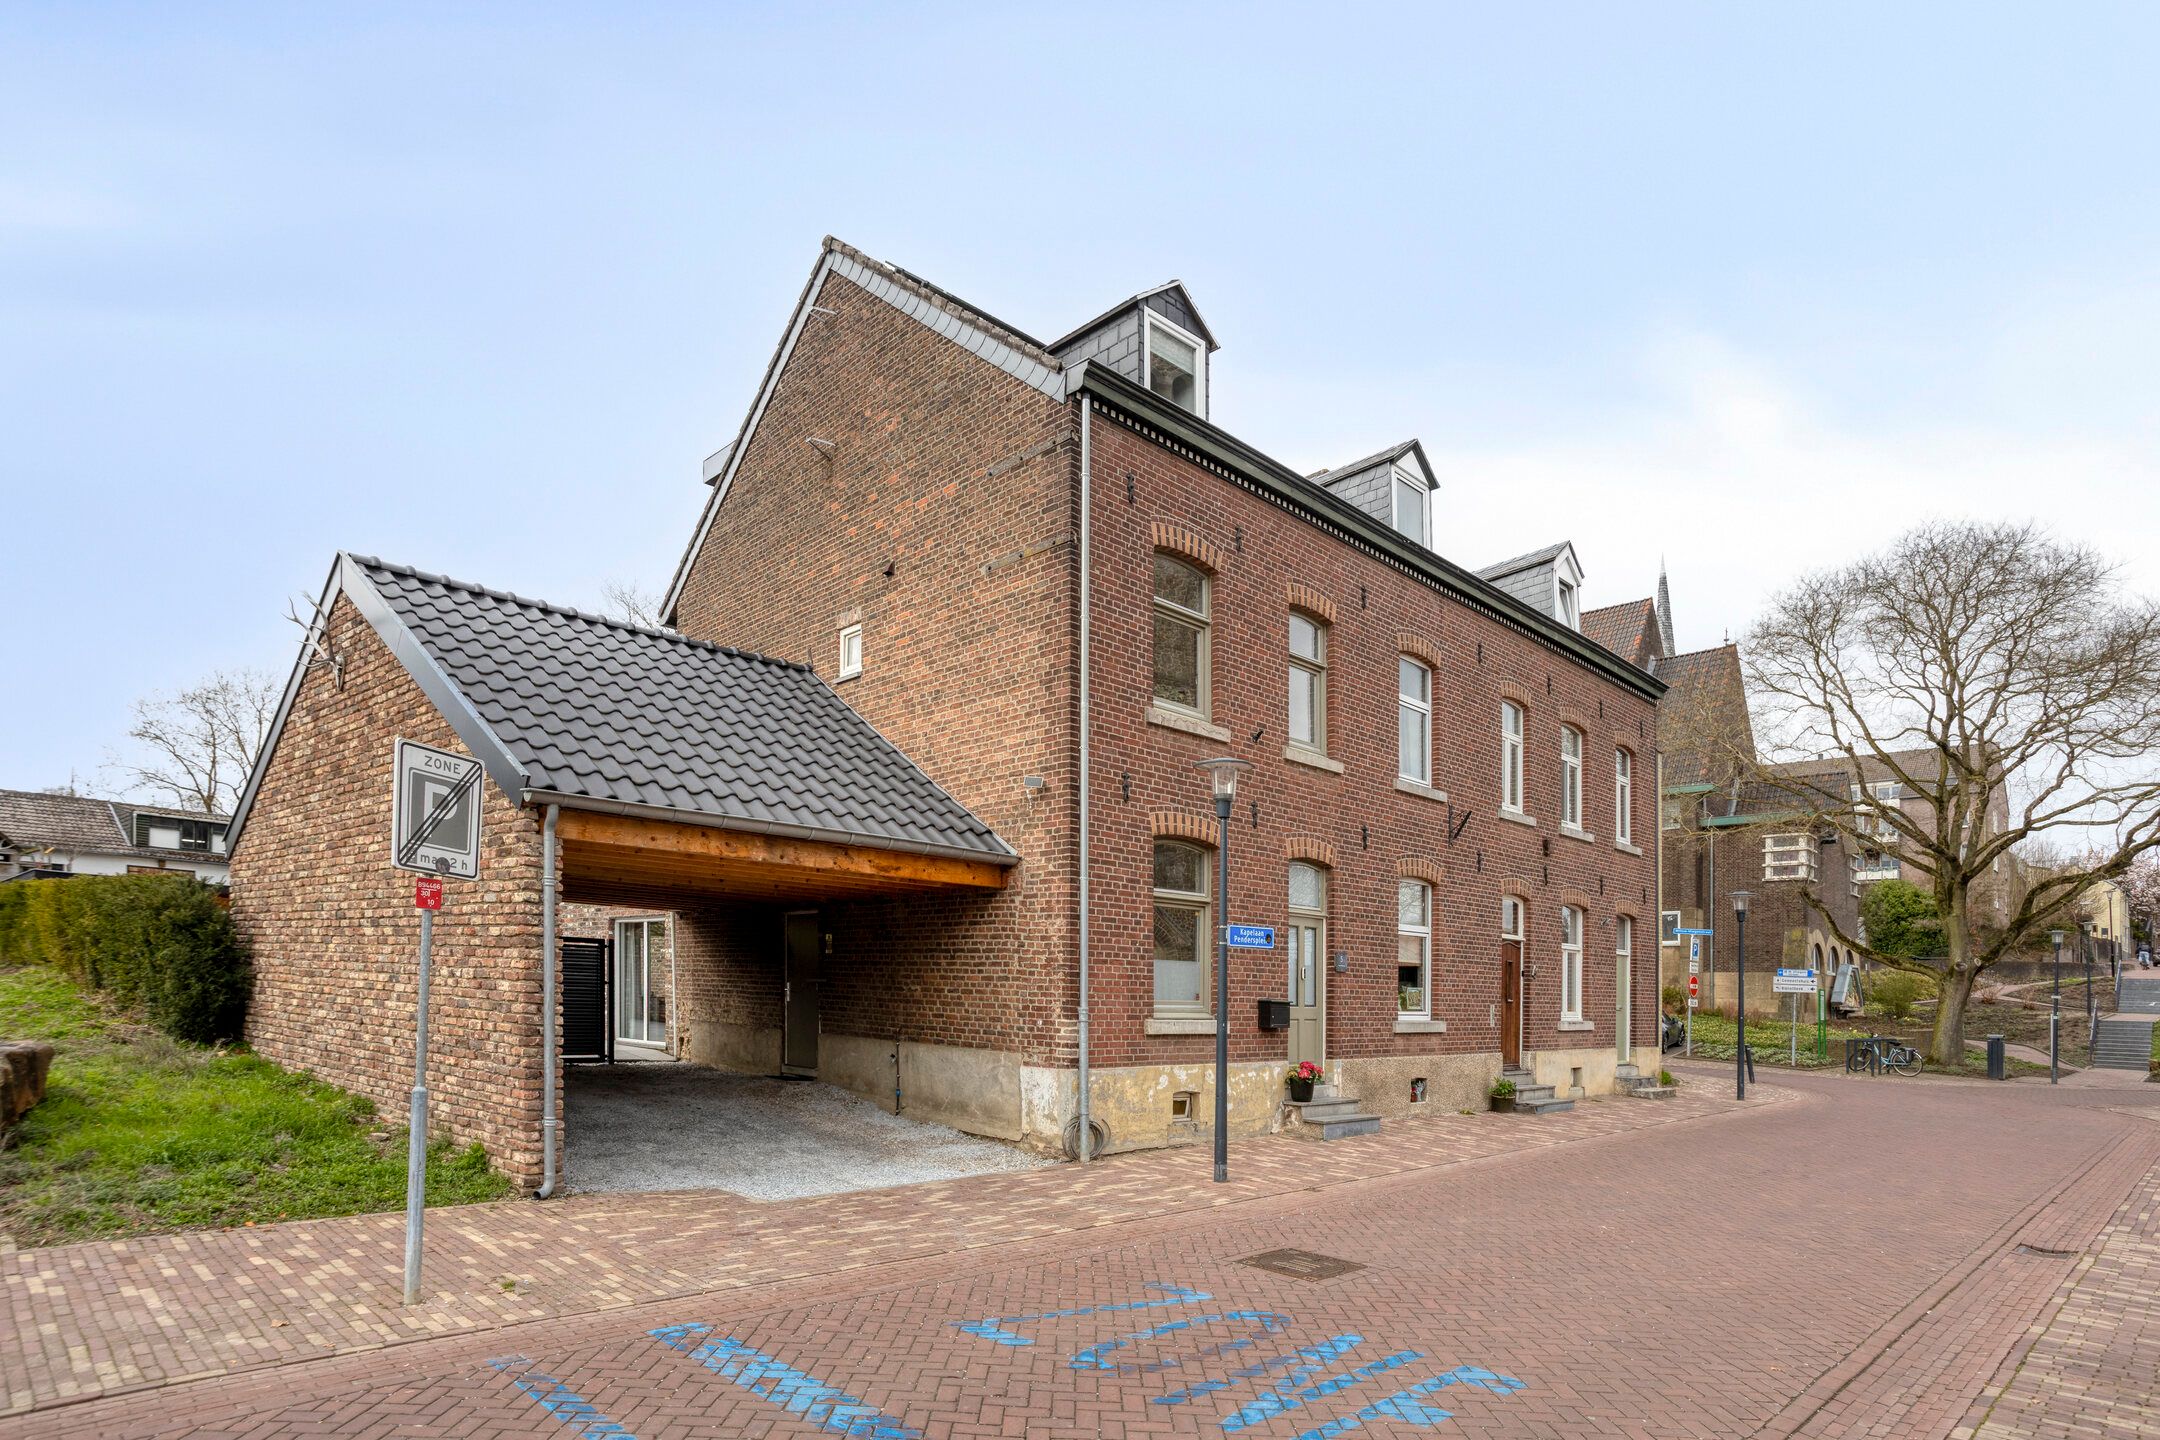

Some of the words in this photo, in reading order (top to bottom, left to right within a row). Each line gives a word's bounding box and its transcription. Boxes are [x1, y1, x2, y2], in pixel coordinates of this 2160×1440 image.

[424, 755, 461, 775] ZONE
[423, 781, 458, 838] P
[420, 854, 442, 866] ma
[450, 857, 457, 869] 2
[461, 859, 468, 870] h
[1234, 935, 1268, 945] Pendersplei
[1240, 928, 1264, 937] Kapelaan
